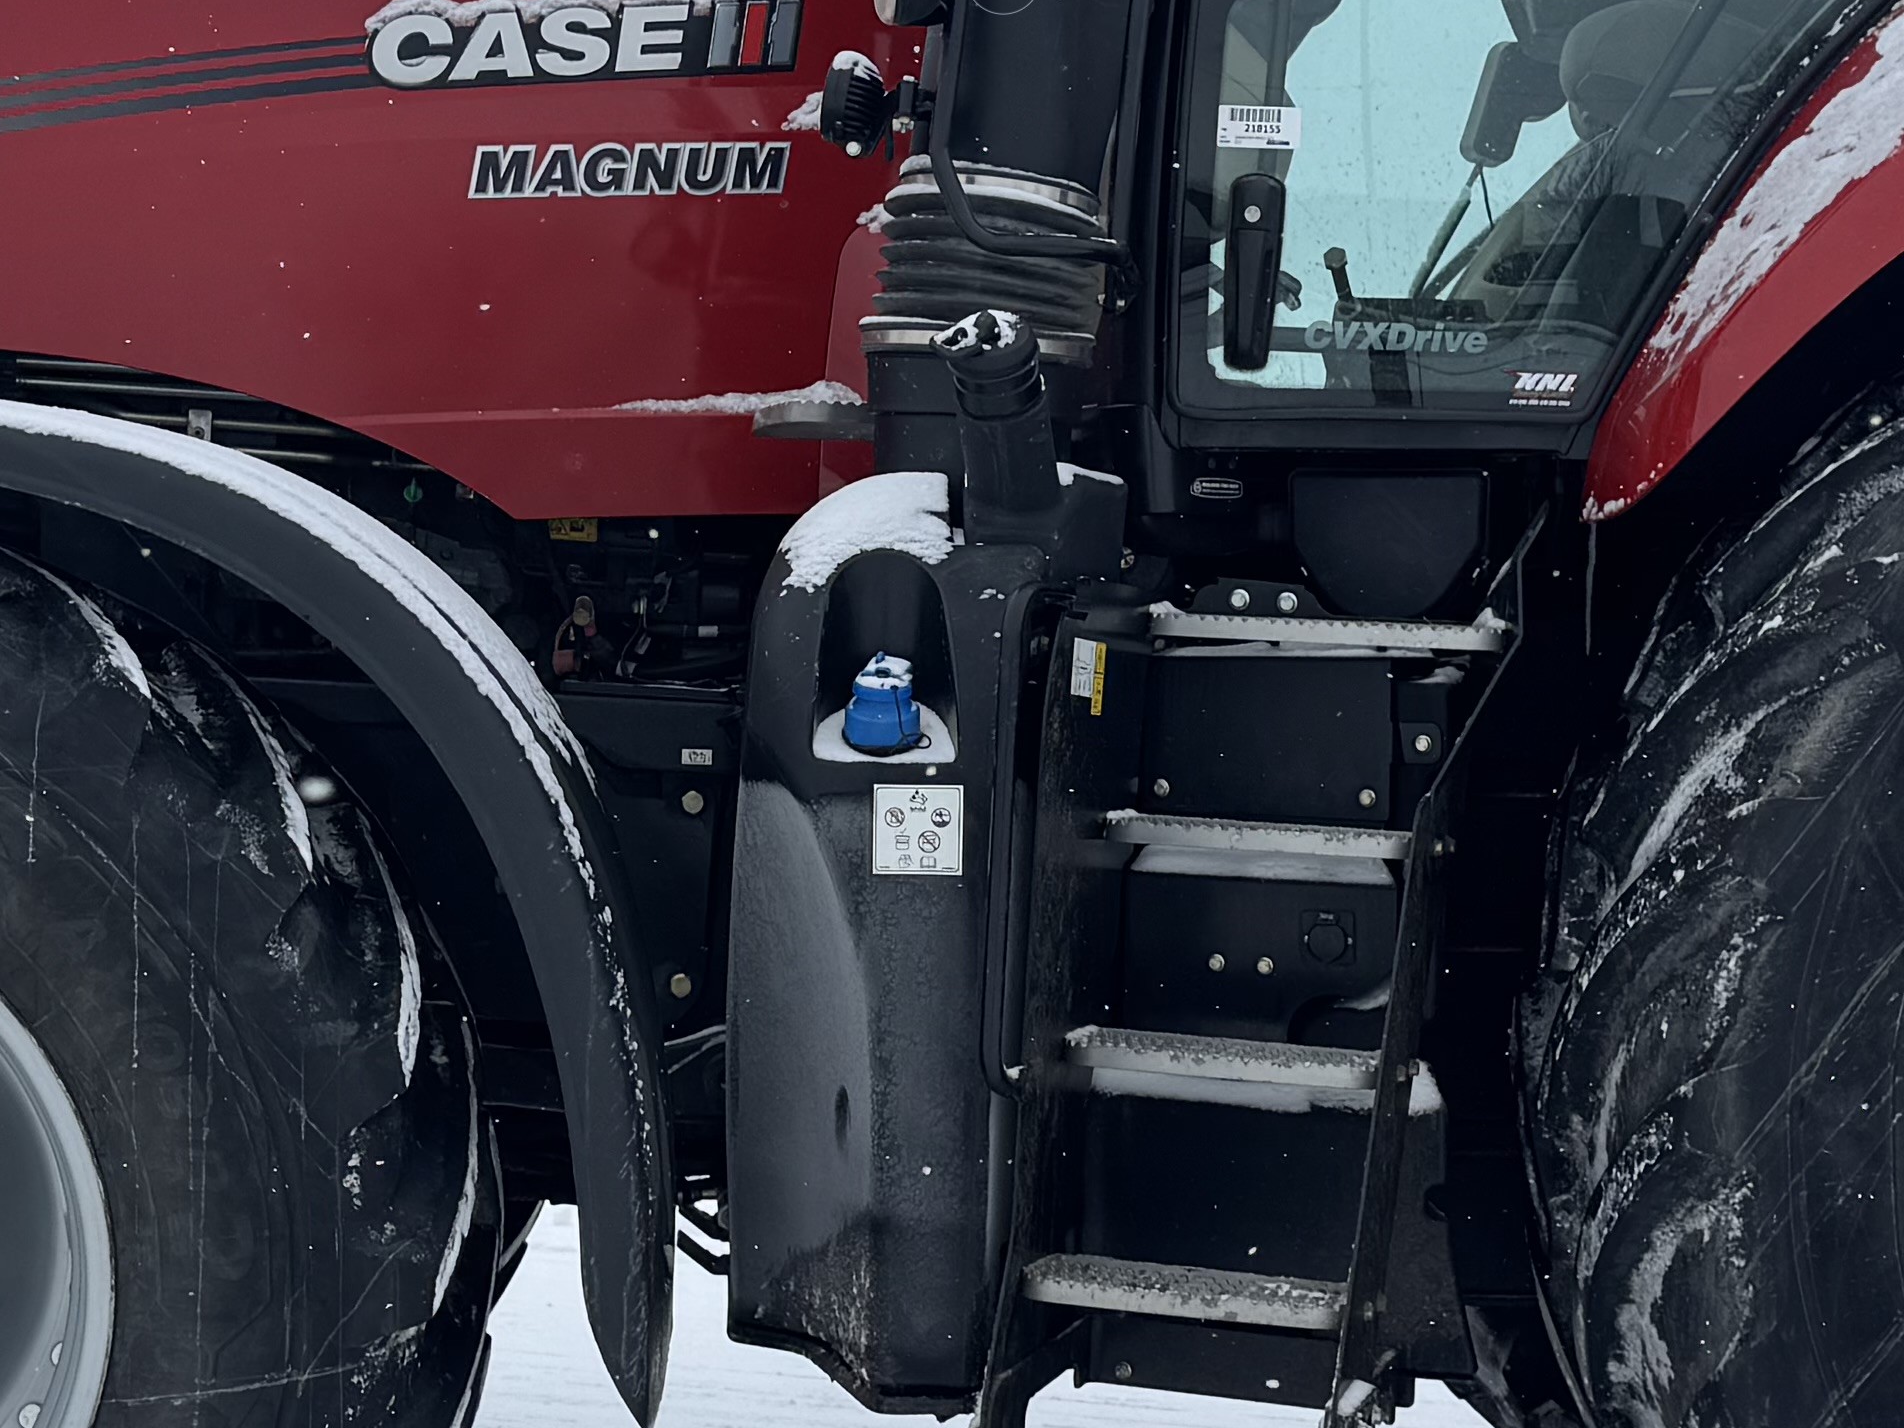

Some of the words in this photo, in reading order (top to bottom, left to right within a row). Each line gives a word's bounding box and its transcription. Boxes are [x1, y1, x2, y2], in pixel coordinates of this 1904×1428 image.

[371, 3, 692, 85] CASE
[468, 142, 791, 199] MAGNUM
[1304, 320, 1488, 354] CVXDrive
